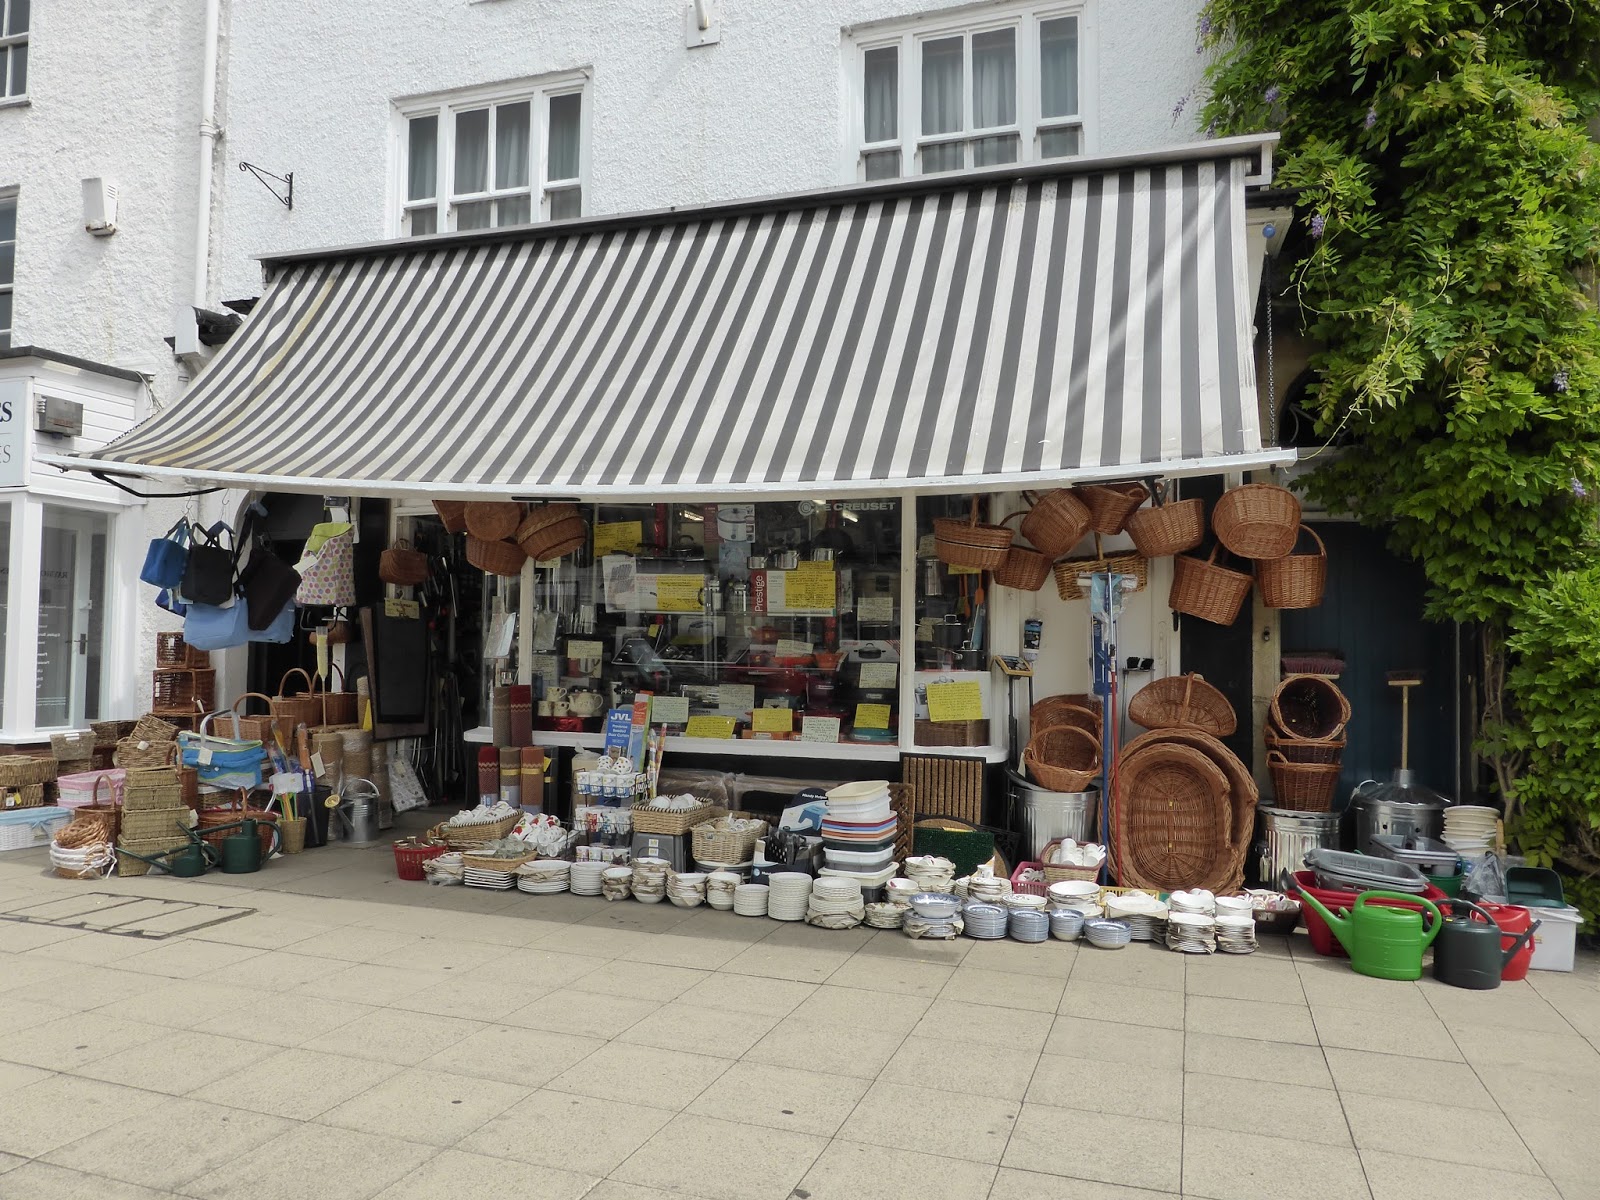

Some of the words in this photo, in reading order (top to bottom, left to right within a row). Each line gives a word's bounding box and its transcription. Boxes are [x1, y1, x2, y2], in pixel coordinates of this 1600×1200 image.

[0, 445, 11, 463] S
[833, 502, 896, 511] CREUSET
[754, 575, 765, 612] Prestige
[611, 713, 631, 721] JVL
